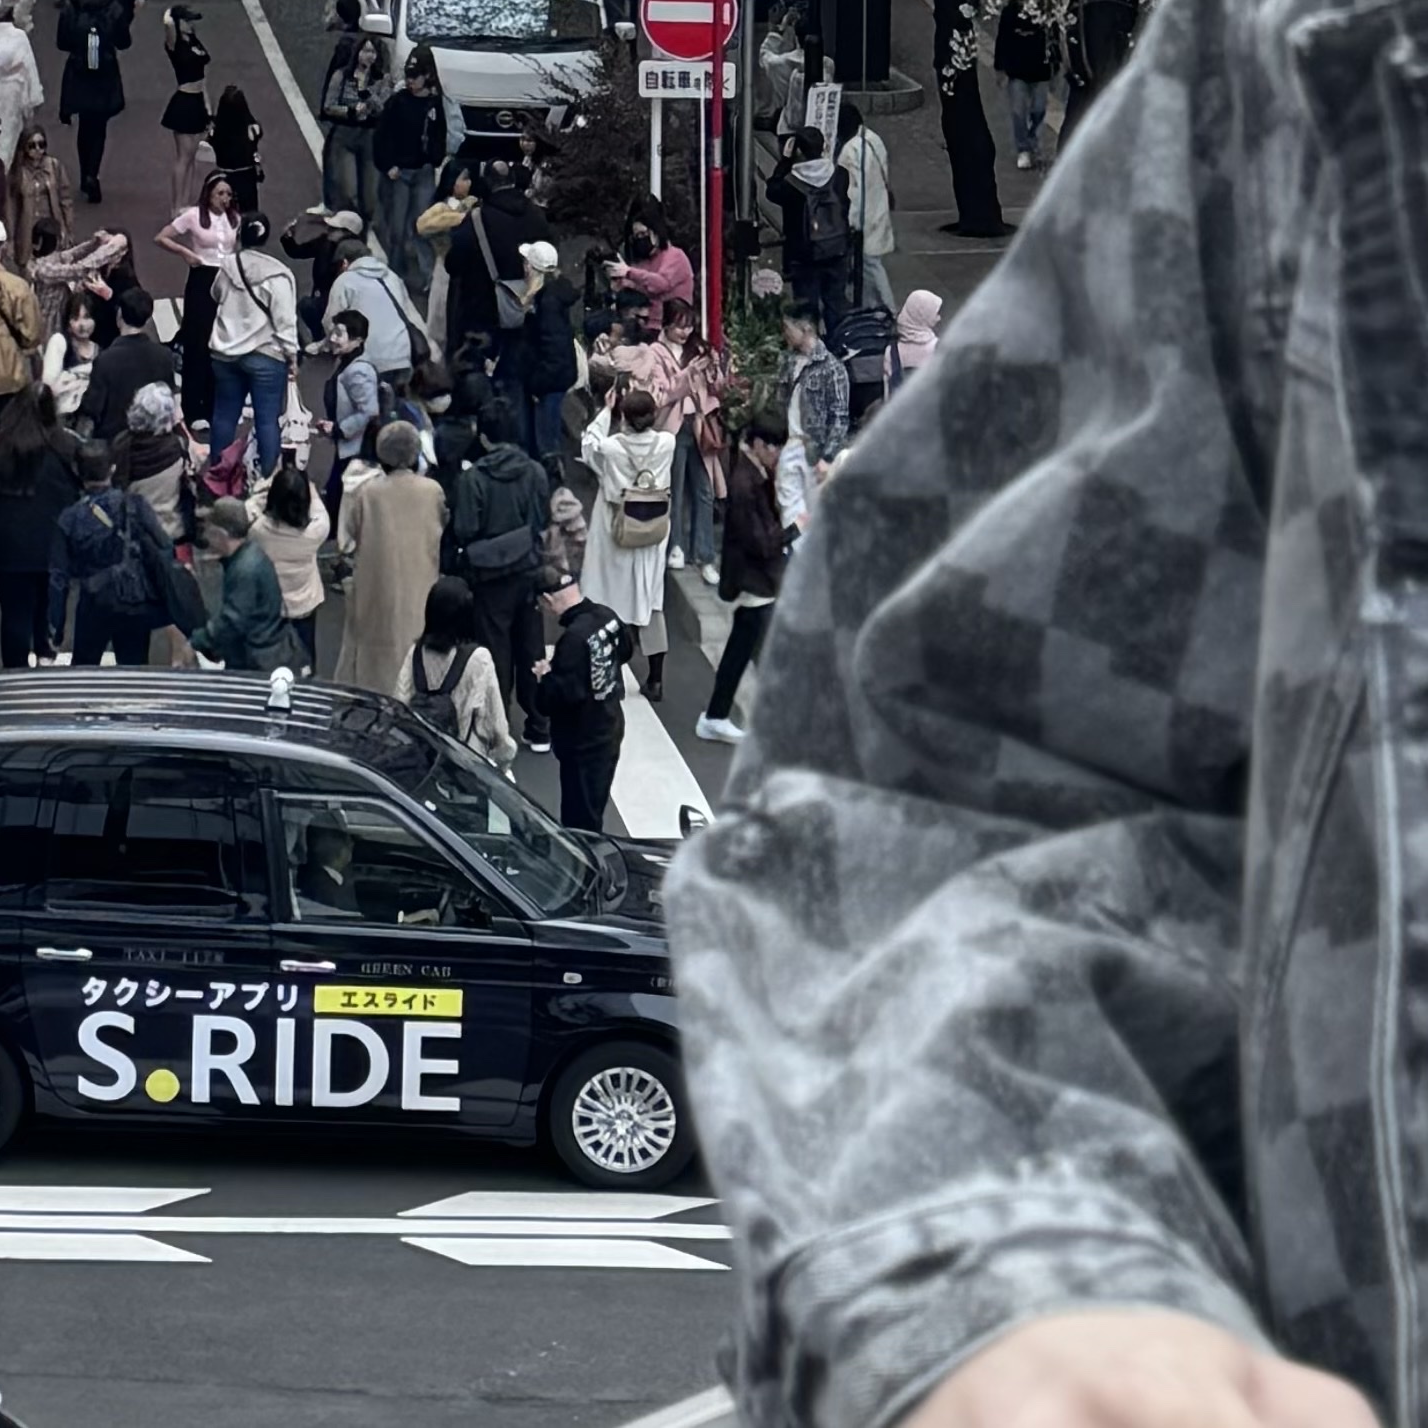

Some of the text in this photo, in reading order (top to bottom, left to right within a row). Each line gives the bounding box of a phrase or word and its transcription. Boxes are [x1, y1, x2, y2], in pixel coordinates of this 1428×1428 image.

[81, 976, 300, 1012] タクシーアプリ
[339, 990, 437, 1012] エスライド
